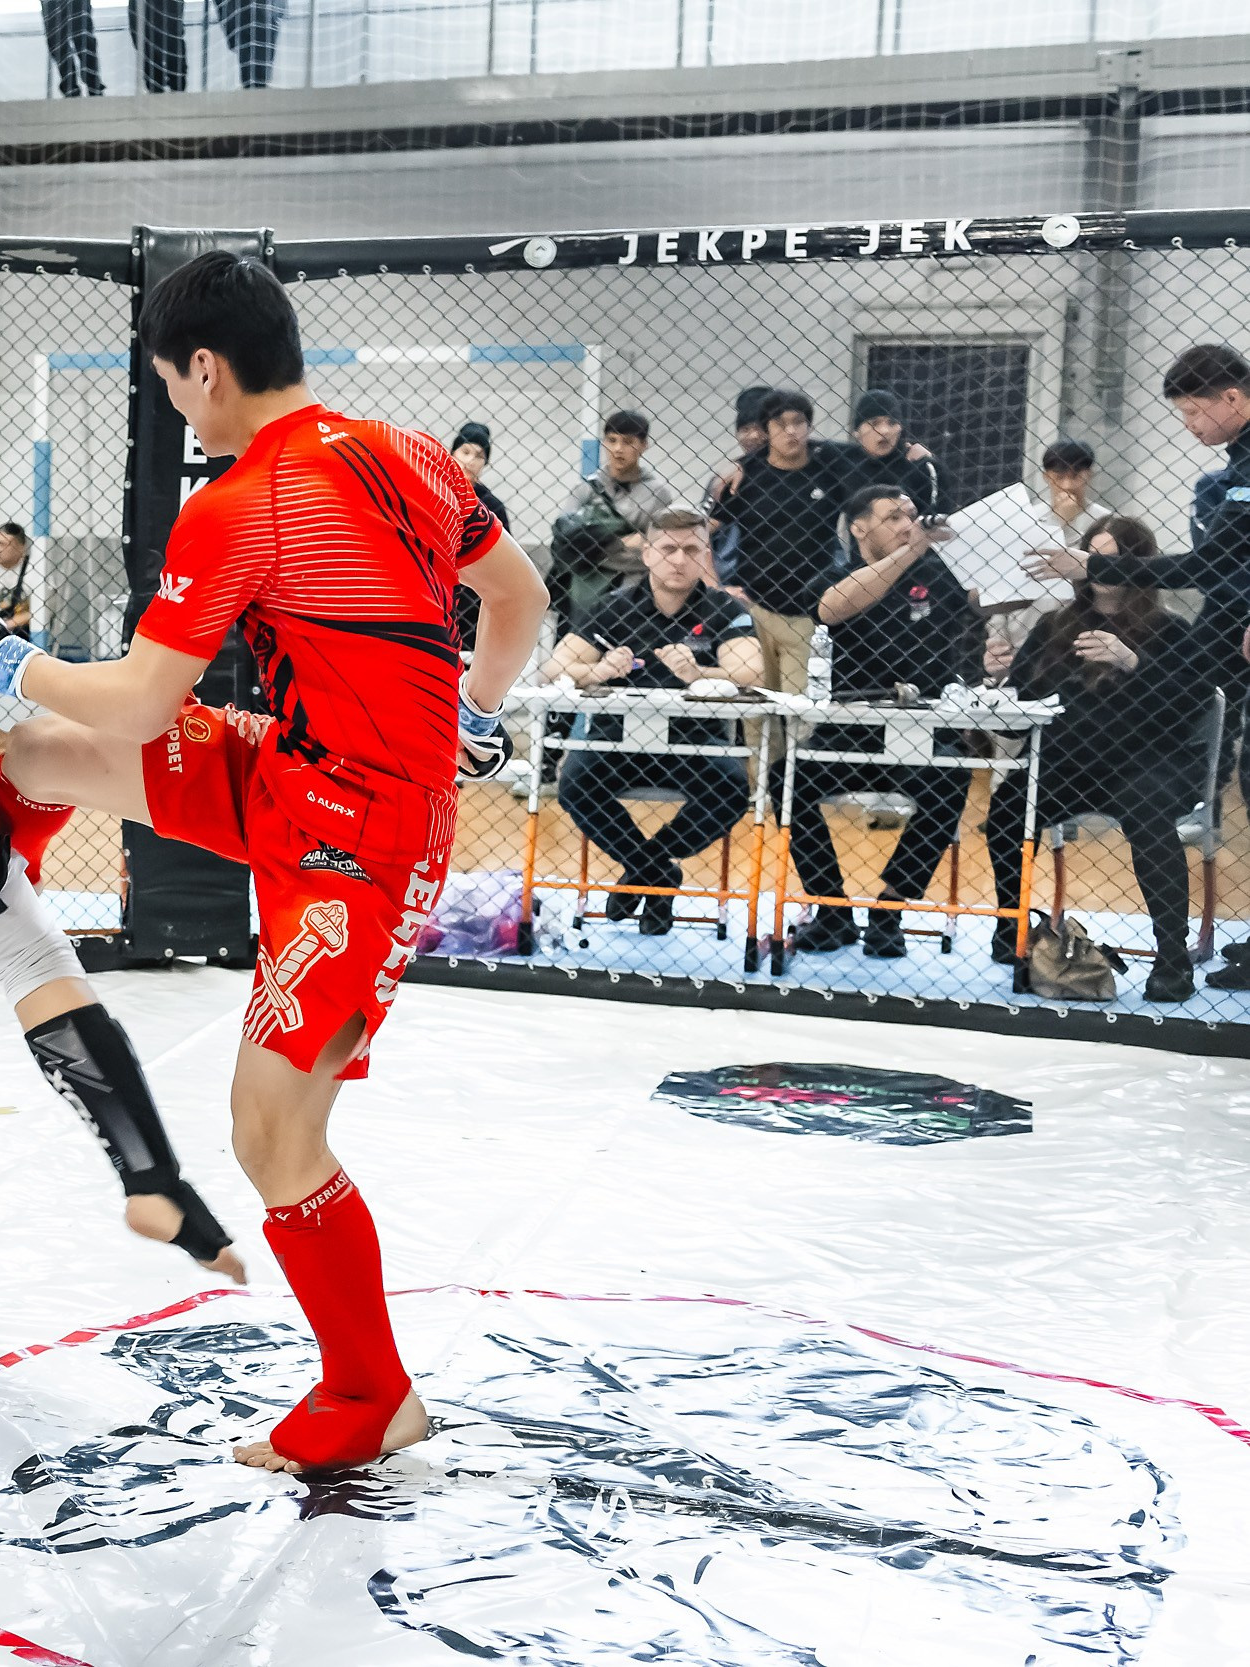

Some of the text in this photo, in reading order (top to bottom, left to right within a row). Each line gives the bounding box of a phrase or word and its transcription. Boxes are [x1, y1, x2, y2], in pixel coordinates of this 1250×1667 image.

[618, 218, 974, 266] JEKPE JEK
[167, 727, 183, 774] PBET
[16, 794, 70, 812] EVERLA
[317, 797, 356, 819] AUR-X
